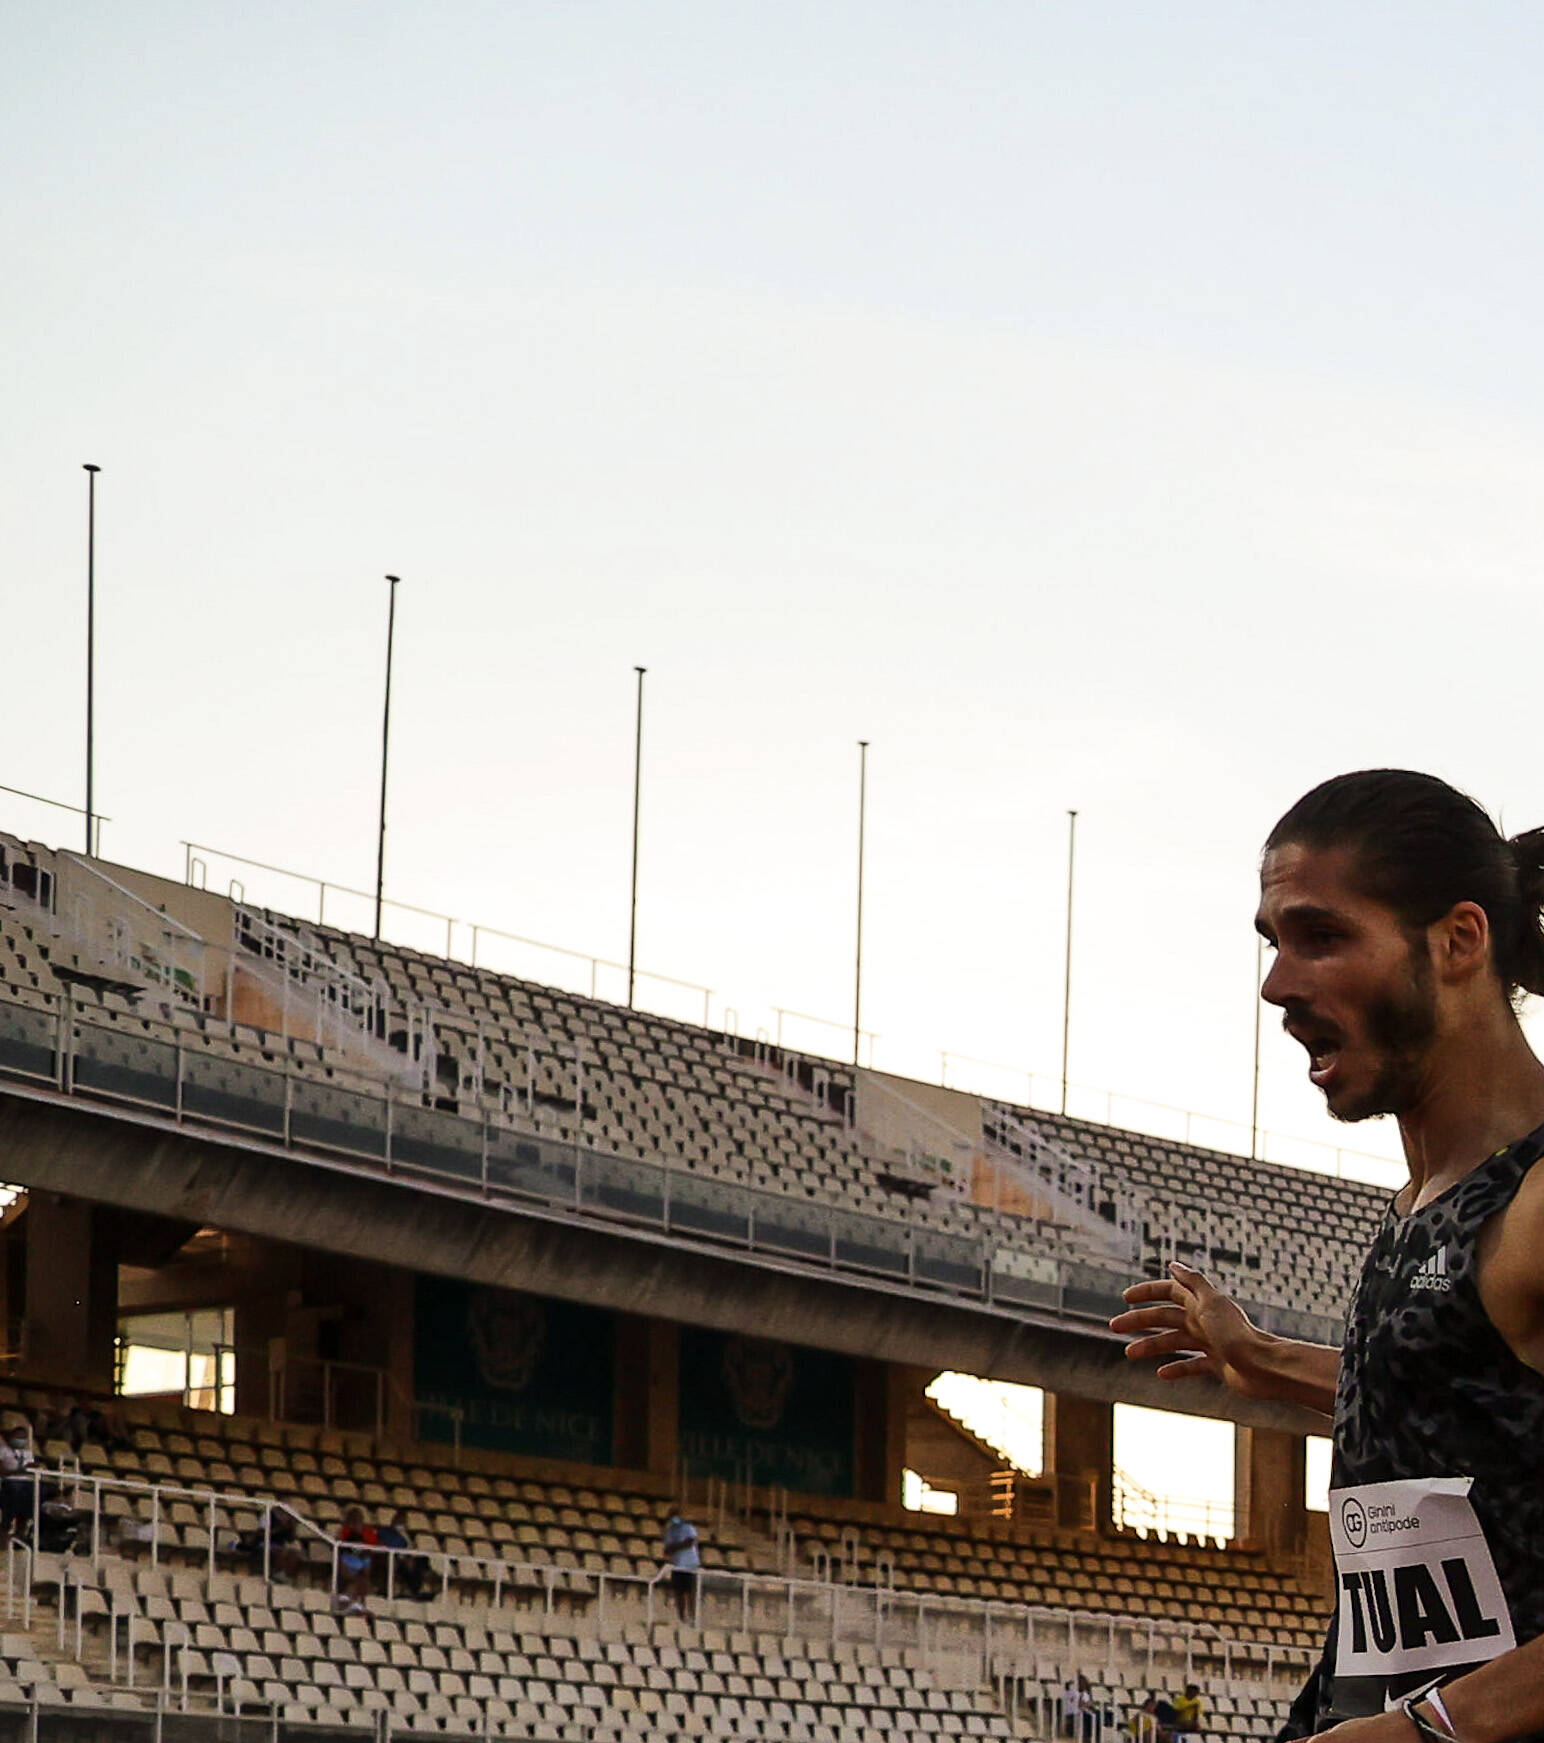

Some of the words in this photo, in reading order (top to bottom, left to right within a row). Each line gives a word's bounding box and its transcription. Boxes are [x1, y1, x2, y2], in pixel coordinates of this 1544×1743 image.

[1409, 1273, 1451, 1292] adidas
[1370, 1516, 1420, 1534] antipode
[1341, 1558, 1501, 1654] TUAL
